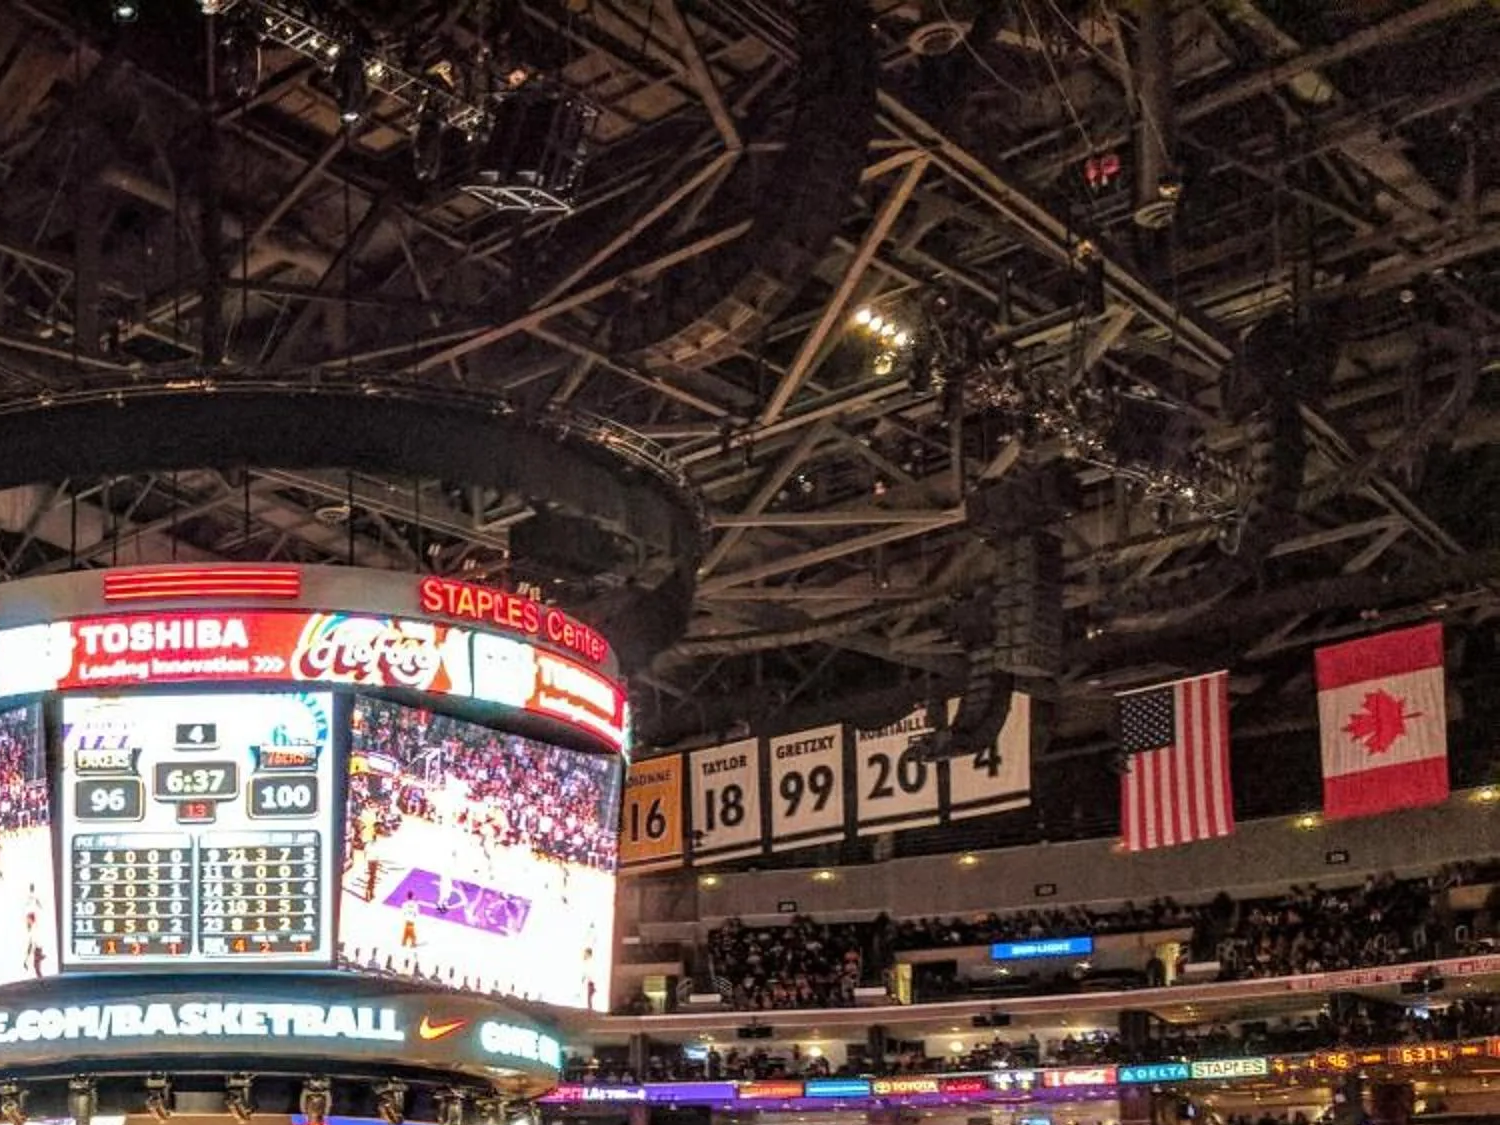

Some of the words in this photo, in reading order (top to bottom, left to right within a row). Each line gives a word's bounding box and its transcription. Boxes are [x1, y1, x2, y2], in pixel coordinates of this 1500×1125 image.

[422, 578, 539, 634] STAPLES
[547, 610, 608, 662] Center
[79, 618, 249, 655] TOSHIBA
[79, 660, 149, 680] Leading
[151, 656, 249, 674] Innovation
[189, 725, 204, 743] 4
[776, 736, 834, 759] GRETZKY
[702, 755, 747, 776] TAYLOR
[868, 747, 927, 799] 20
[167, 770, 225, 792] 6:37
[261, 785, 310, 808] 100
[780, 764, 834, 817] 99
[91, 788, 125, 811] 96
[186, 804, 206, 818] 13
[706, 784, 744, 831] 18
[632, 798, 666, 842] 16
[103, 850, 115, 863] 4
[125, 850, 136, 863] 0
[147, 850, 159, 863] 0
[170, 850, 182, 863] 0
[228, 848, 248, 861] 21
[256, 848, 266, 861] 3
[280, 848, 291, 861] 7
[303, 848, 314, 861] 5
[100, 867, 118, 880] 25
[125, 867, 136, 880] 0
[147, 867, 159, 880] 5
[204, 865, 223, 878] 11
[256, 865, 266, 878] 0
[280, 865, 291, 878] 0
[303, 865, 314, 878] 3
[80, 884, 91, 897] 7
[103, 884, 115, 897] 5
[125, 884, 136, 897] 0
[147, 884, 159, 897] 3
[170, 884, 182, 897] 1
[204, 882, 223, 896] 14
[232, 882, 243, 896] 3
[256, 882, 266, 896] 0
[280, 882, 291, 896] 1
[303, 882, 314, 896] 4
[75, 901, 95, 915] 10
[103, 901, 115, 915] 2
[125, 901, 136, 915] 2
[147, 901, 159, 915] 1
[170, 901, 182, 915] 0
[228, 900, 248, 914] 10
[256, 900, 266, 914] 3
[280, 900, 291, 914] 5
[303, 900, 314, 914] 1
[125, 919, 136, 932] 5
[147, 919, 159, 932] 0
[170, 919, 182, 932] 2
[204, 917, 223, 931] 23
[256, 917, 266, 931] 1
[280, 917, 291, 931] 2
[303, 917, 314, 931] 1
[1328, 1054, 1348, 1067] 96
[1137, 1066, 1188, 1080] DELTA
[1196, 1060, 1264, 1077] STAPLES
[891, 1081, 938, 1093] TOYOTA
